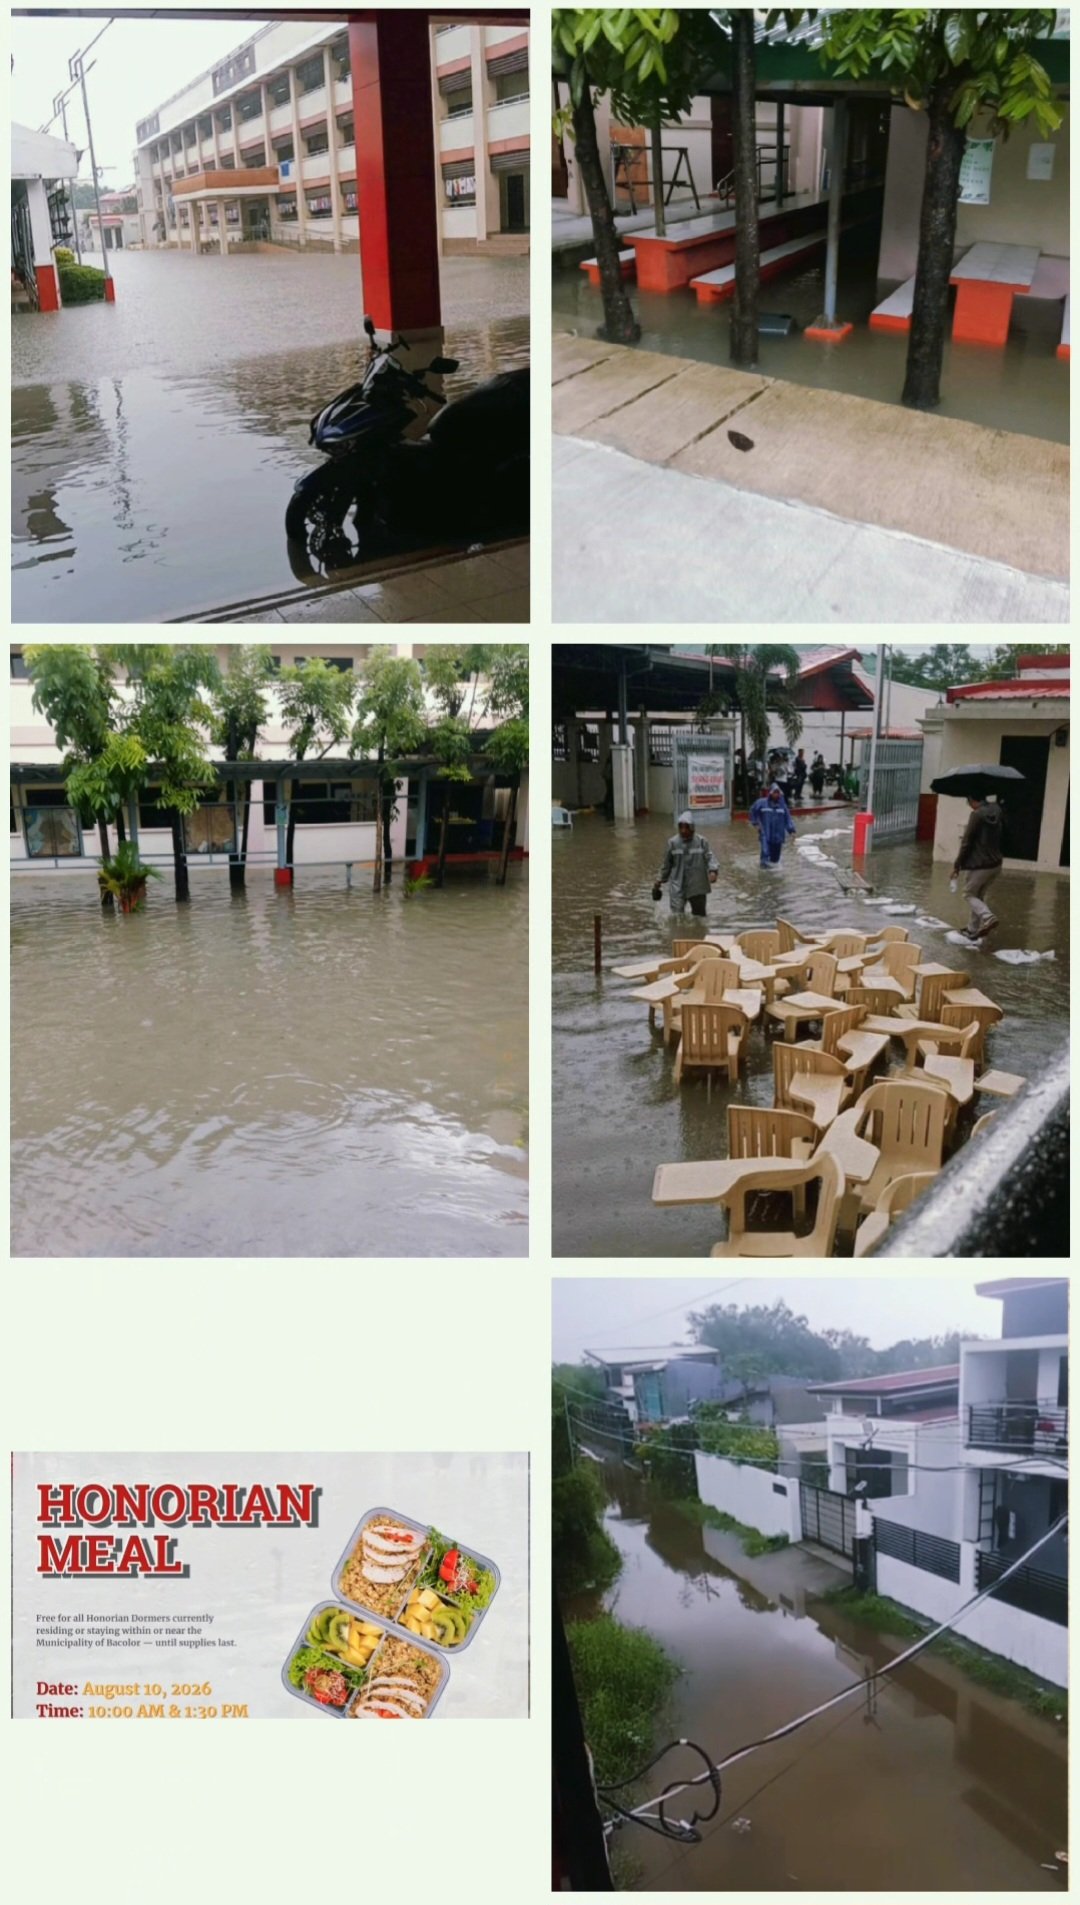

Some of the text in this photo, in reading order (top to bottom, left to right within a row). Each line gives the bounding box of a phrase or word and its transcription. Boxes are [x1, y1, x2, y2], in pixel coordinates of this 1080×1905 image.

[37, 1483, 321, 1527] HONORIAN
[37, 1534, 189, 1578] MEAL
[36, 1613, 214, 1624] Free for all Honorian Dormers currently
[36, 1626, 73, 1636] residing
[86, 1626, 120, 1636] staying
[122, 1626, 151, 1635] within
[187, 1626, 202, 1635] the
[36, 1638, 93, 1648] Municipality
[94, 1638, 105, 1647] of
[106, 1638, 141, 1647] Bacolor
[155, 1638, 177, 1647] until
[178, 1638, 217, 1648] supplies
[218, 1638, 237, 1647] last.
[36, 1681, 212, 1700] Date: August 10, 2026
[36, 1703, 249, 1719] Time: 10:00 AM & 1:30 PM
